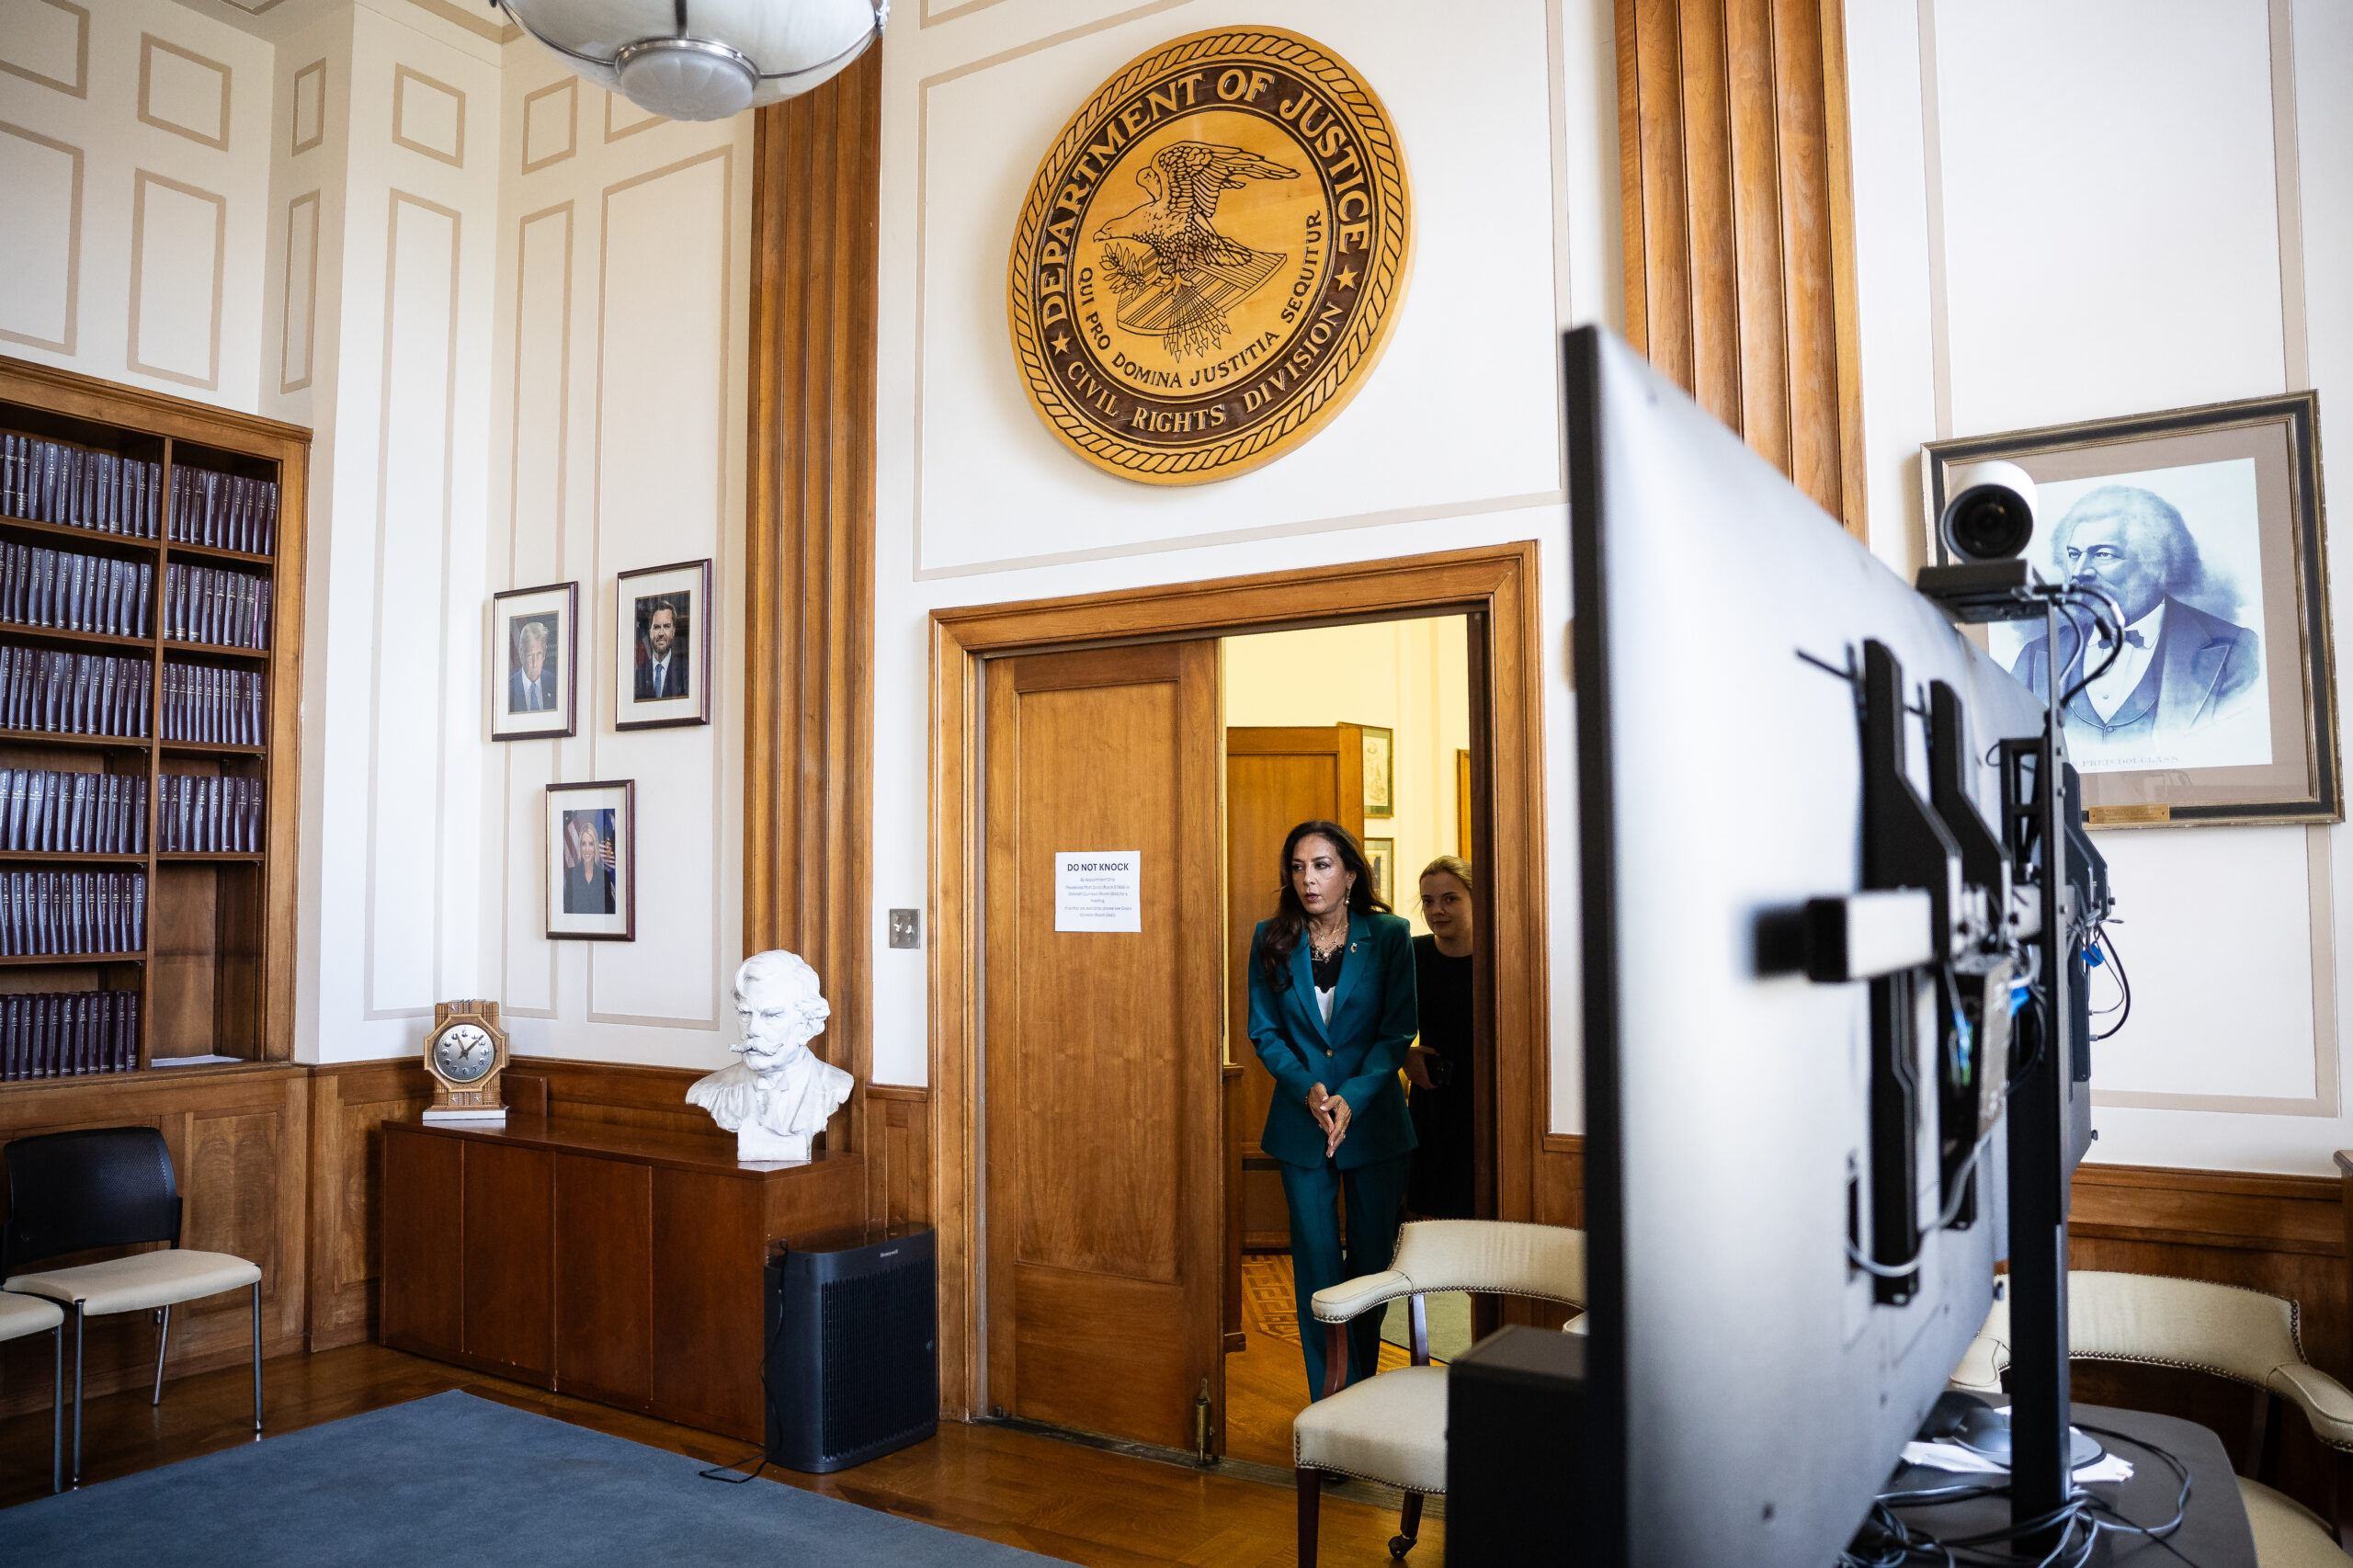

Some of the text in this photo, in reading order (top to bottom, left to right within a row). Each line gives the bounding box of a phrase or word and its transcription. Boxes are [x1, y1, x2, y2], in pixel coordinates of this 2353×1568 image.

[1041, 69, 1370, 330] DEPARTMENT OF JUSTICE
[1067, 301, 1346, 433] CIVIL RIGHTS DIVISION
[1078, 210, 1322, 389] QUI PRO DOMINA JUSTITIA SEQUITUR
[1067, 863, 1129, 871] DO NOT KNOCK
